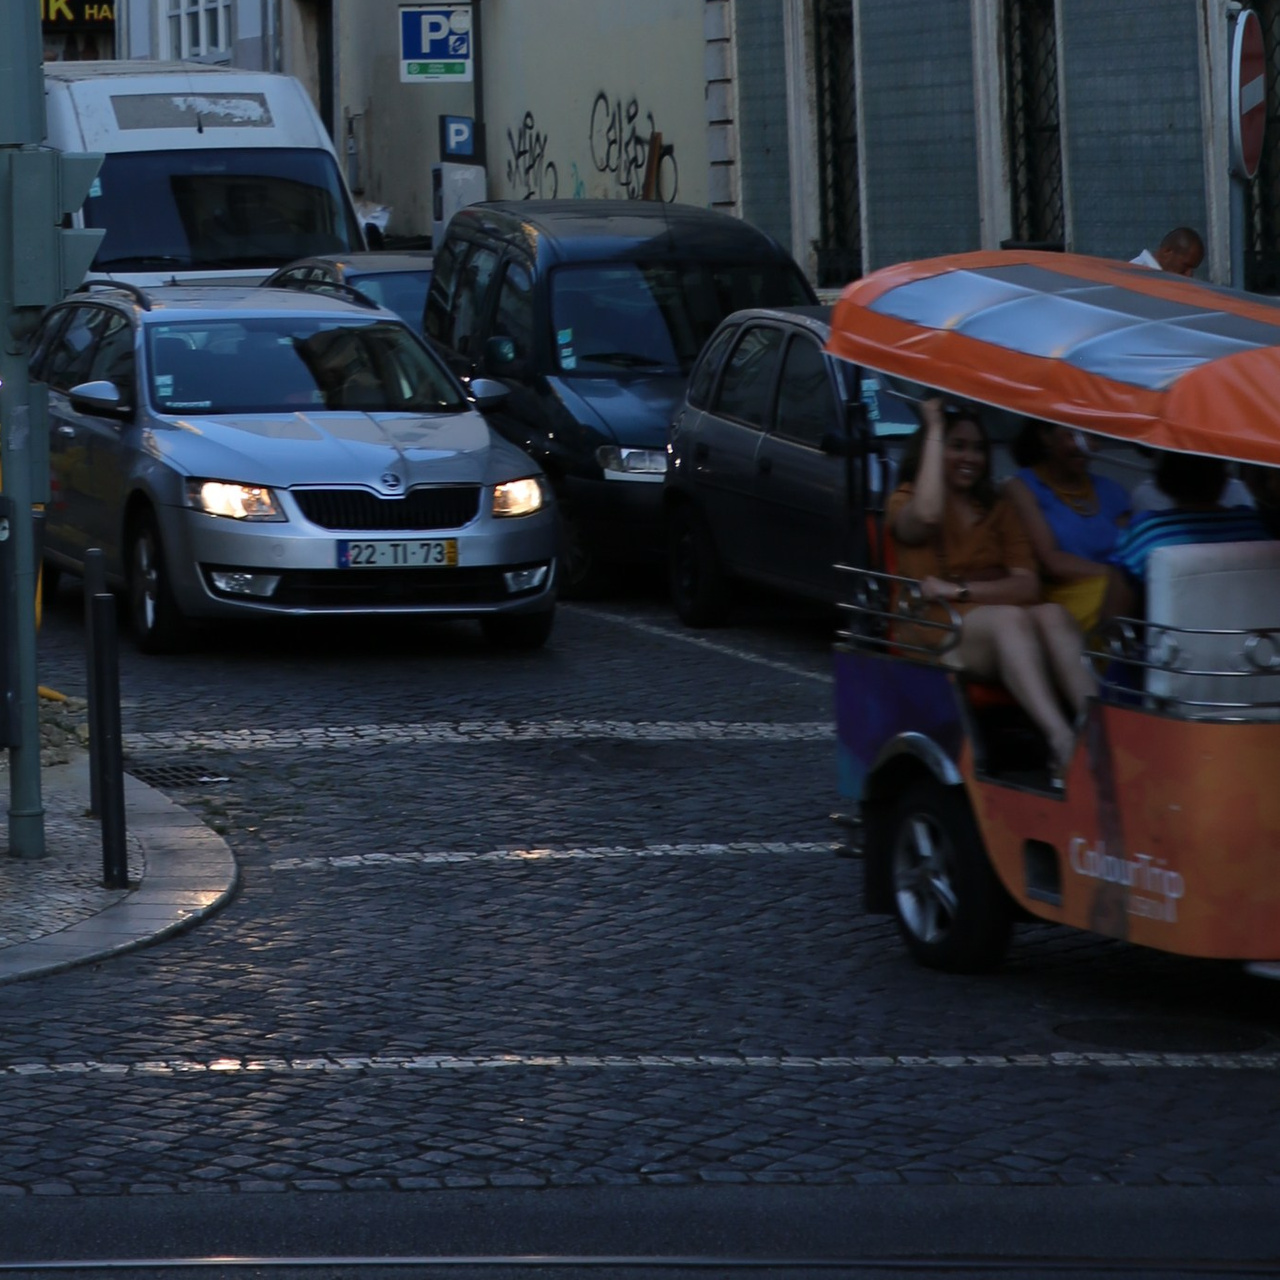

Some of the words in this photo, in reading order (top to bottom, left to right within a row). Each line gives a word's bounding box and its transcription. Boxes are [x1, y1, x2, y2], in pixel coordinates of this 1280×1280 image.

[85, 5, 116, 20] HA
[421, 14, 450, 53] P
[449, 124, 469, 149] P
